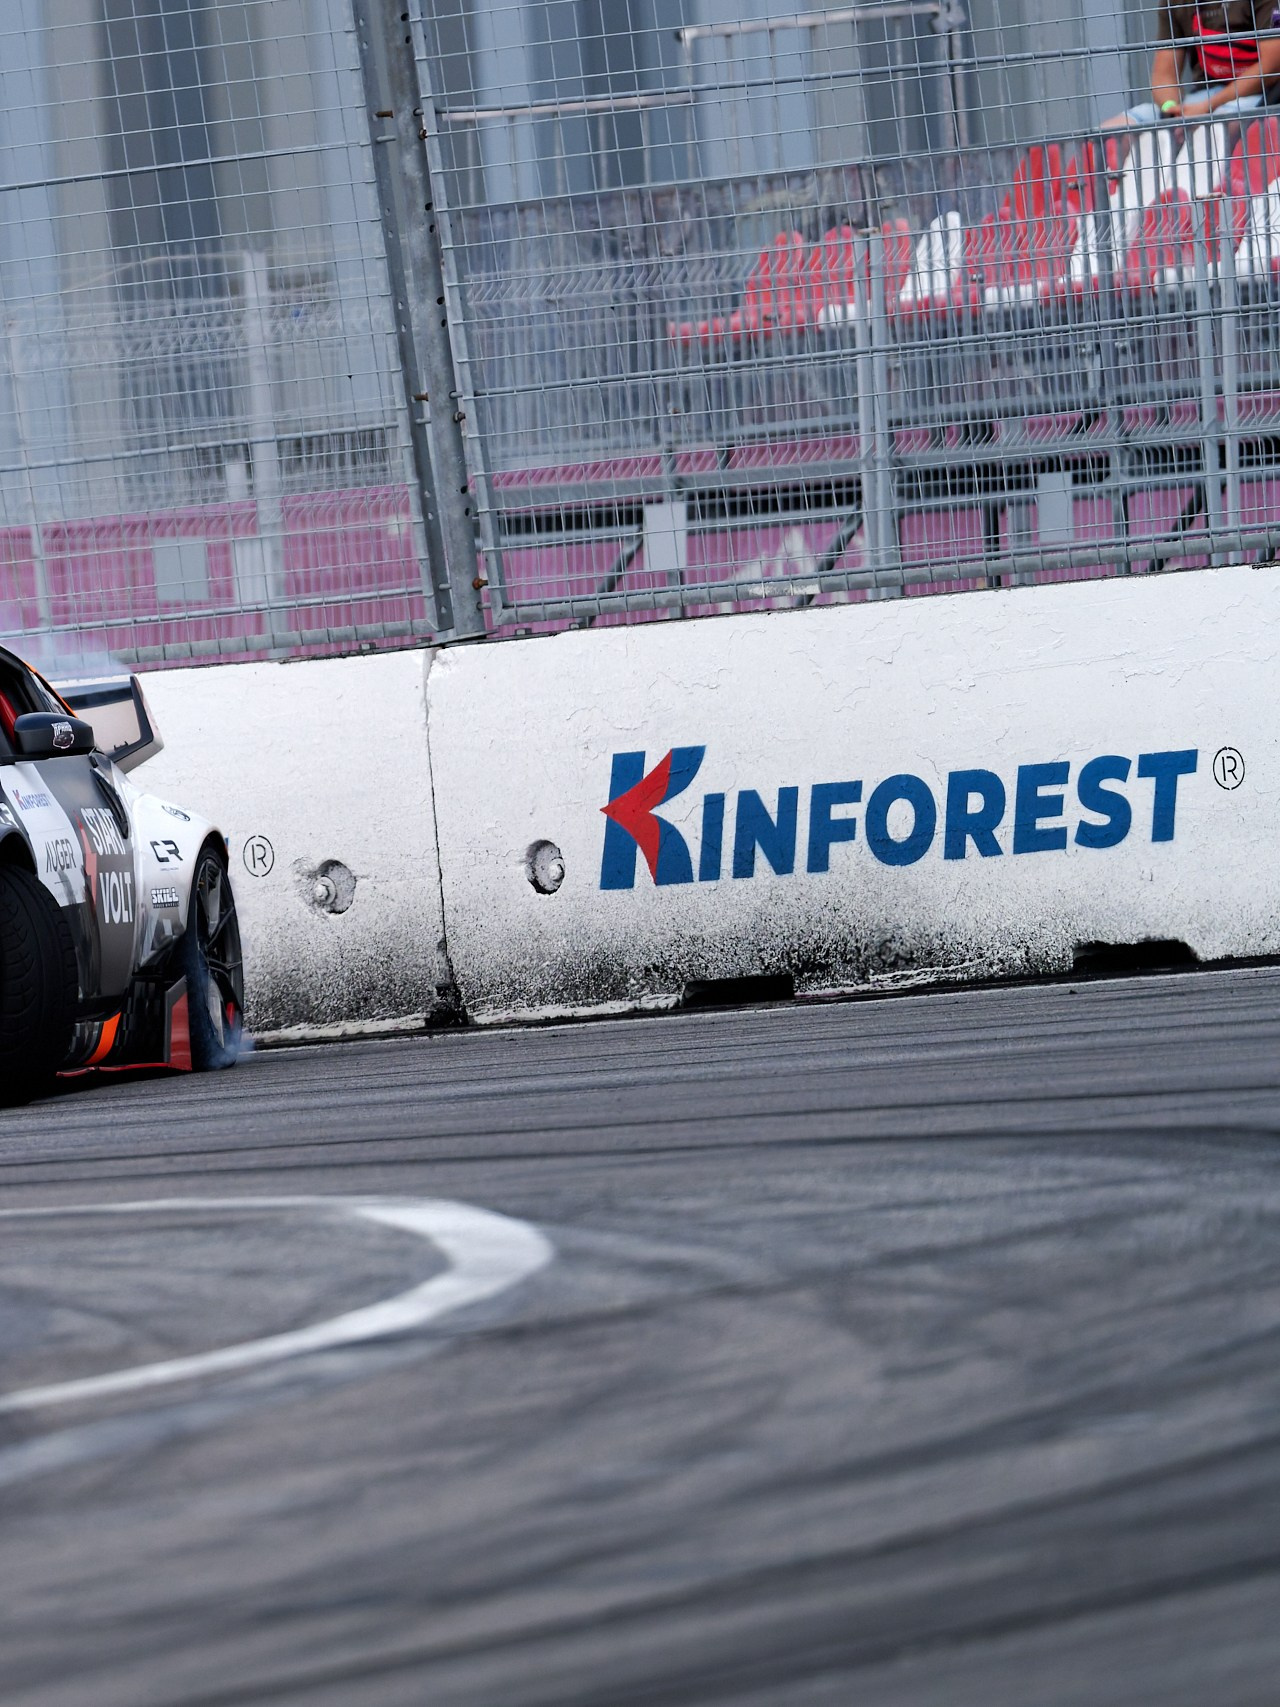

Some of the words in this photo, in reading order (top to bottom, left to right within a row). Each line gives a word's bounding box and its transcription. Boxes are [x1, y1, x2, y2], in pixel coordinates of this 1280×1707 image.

[80, 807, 126, 856] START
[600, 745, 1198, 891] KINFOREST
[99, 871, 133, 924] VOLT
[151, 887, 179, 904] SKILL
